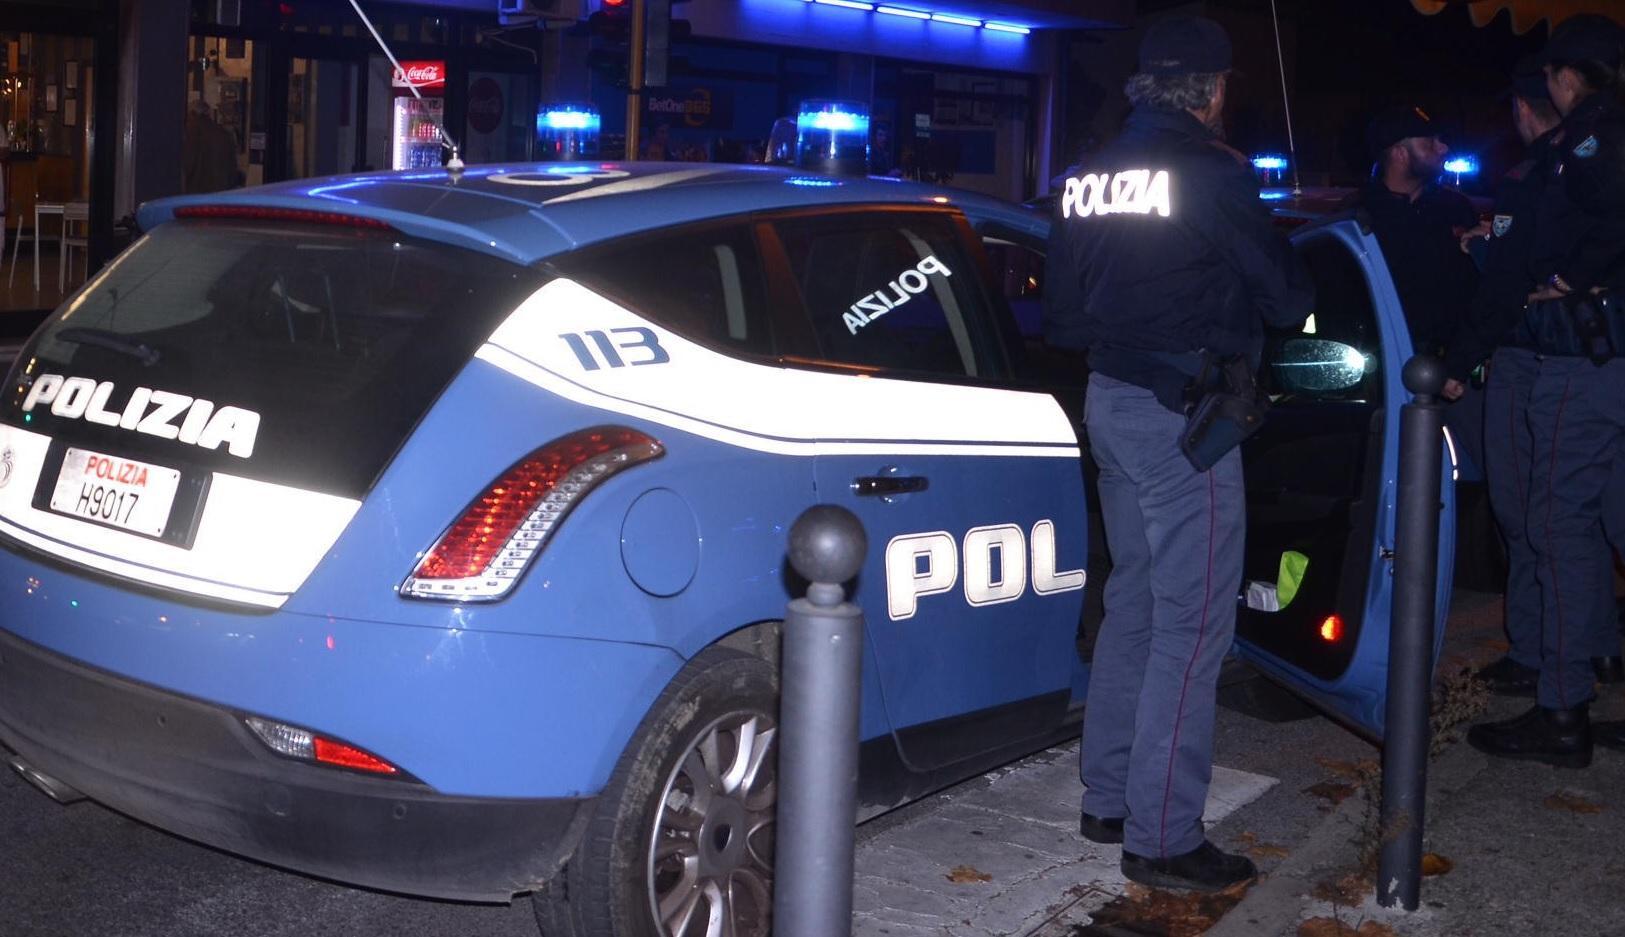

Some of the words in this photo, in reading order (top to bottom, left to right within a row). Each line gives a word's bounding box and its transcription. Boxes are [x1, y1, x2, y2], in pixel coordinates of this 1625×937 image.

[1062, 169, 1170, 219] POLIZIA
[558, 326, 670, 371] 113
[21, 373, 261, 459] POLIZIA
[84, 455, 150, 487] POLIZIA
[76, 482, 139, 524] H9017
[885, 518, 1087, 621] POL
